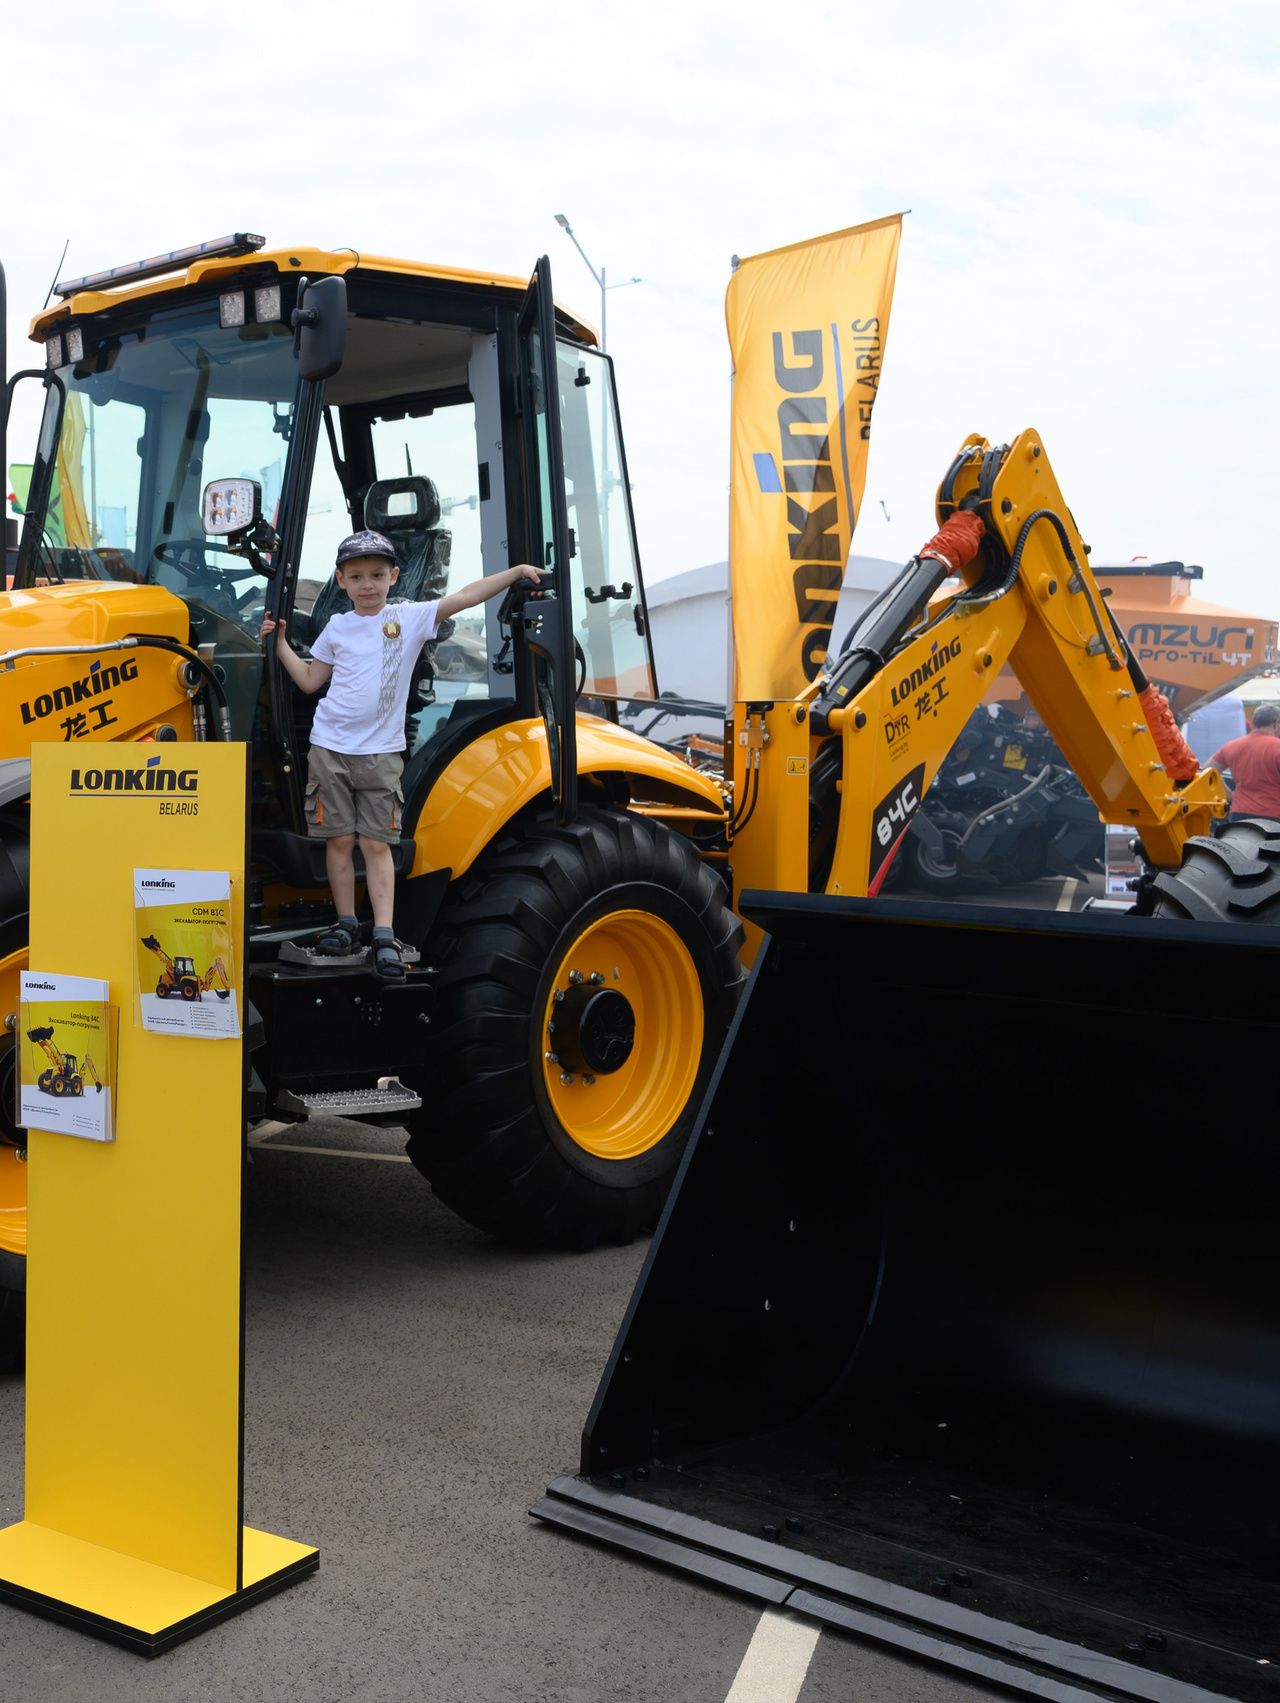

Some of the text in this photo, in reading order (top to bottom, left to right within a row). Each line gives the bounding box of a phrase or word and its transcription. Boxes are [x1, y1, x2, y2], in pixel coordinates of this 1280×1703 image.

[751, 329, 843, 683] ONKING
[890, 635, 962, 708] LONKING
[20, 657, 139, 725] LONKING
[70, 755, 198, 791] LONKING
[159, 802, 199, 816] BELARUS
[876, 781, 918, 846] 84C
[141, 878, 176, 888] LONKING
[191, 907, 225, 917] CDM 83C
[25, 981, 56, 991] LONKING
[70, 1011, 91, 1023] Lonking
